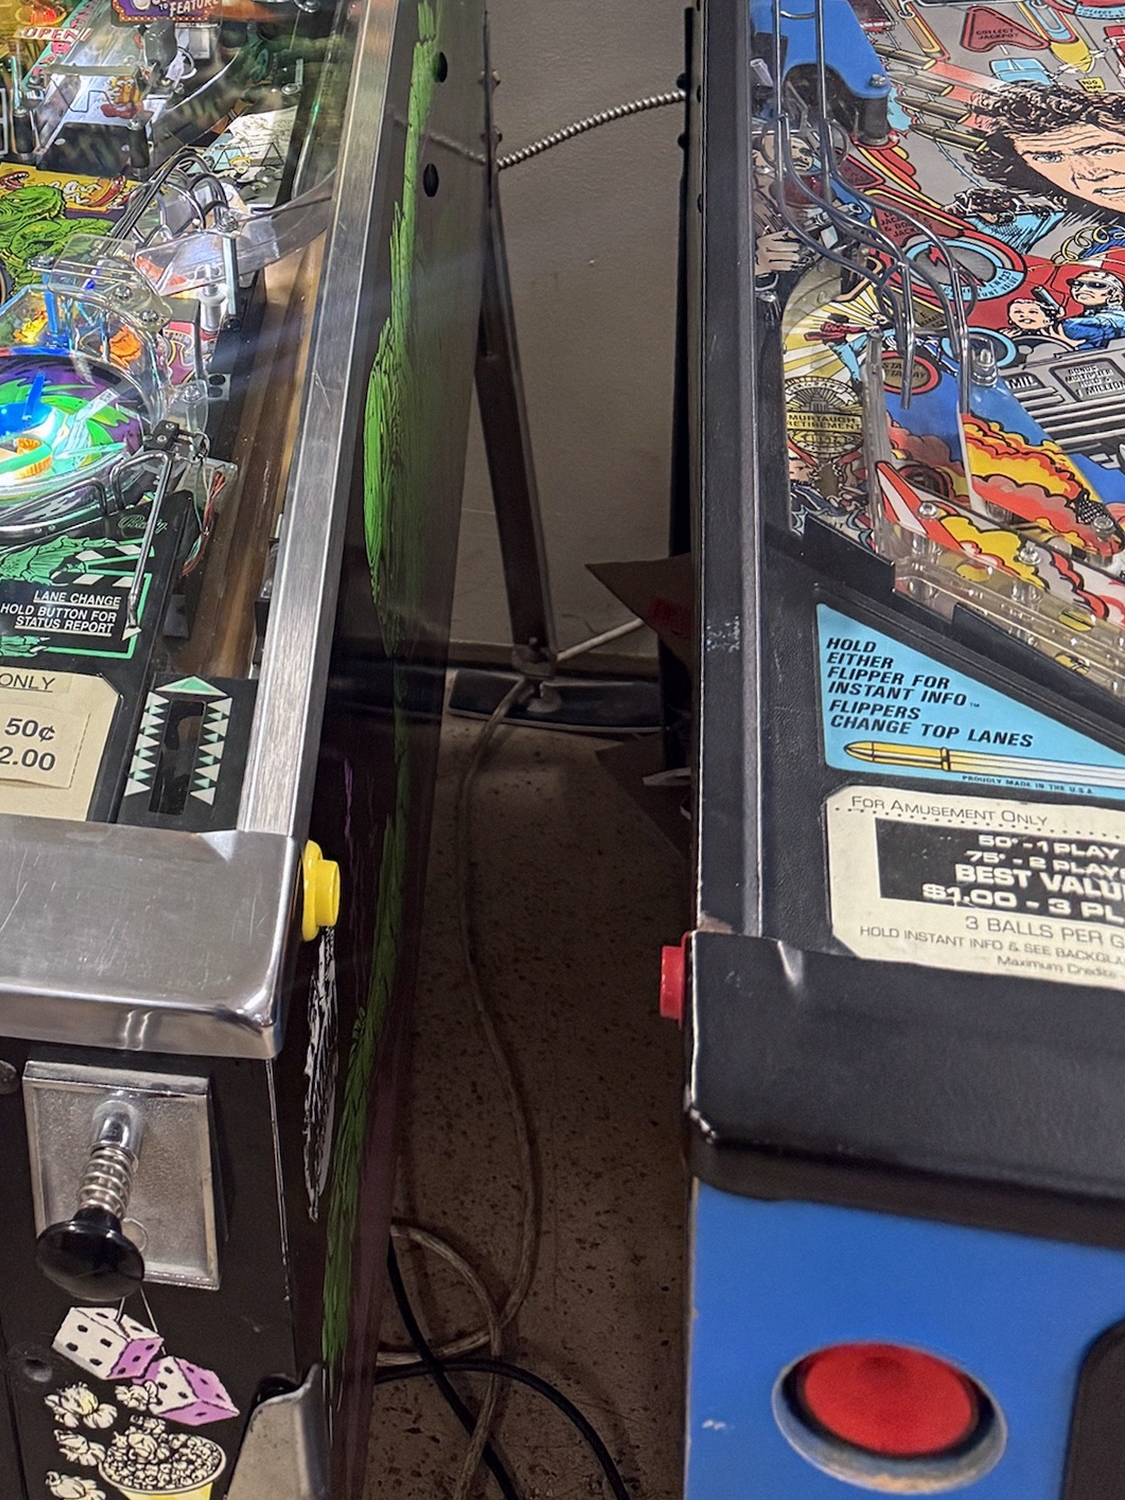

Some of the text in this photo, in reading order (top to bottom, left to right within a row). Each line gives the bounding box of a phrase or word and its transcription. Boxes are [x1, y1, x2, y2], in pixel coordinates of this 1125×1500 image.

[788, 415, 857, 425] MURTAUGH
[117, 514, 168, 534] Baly
[33, 590, 122, 607] LANE CHANGE
[0, 603, 118, 623] HOLD BUTTON FOR
[15, 615, 114, 634] STATUS REPORT
[826, 637, 877, 653] HOLD
[827, 652, 894, 669] EITHER
[827, 666, 950, 690] FLIPPER FOR
[828, 681, 915, 701] INSTANT
[921, 690, 967, 707] INFO
[829, 700, 921, 720] FLIPPERS
[4, 717, 57, 743] 50¢
[830, 716, 1034, 748] CHANGE TOP LANES
[962, 775, 1002, 784] PROUDLY
[1053, 842, 1119, 860] PLAY
[1029, 856, 1047, 870] 2
[955, 864, 1125, 901] BEST VALU
[923, 883, 1017, 908] $1.00
[1048, 898, 1071, 915] 3
[860, 926, 900, 939] HOLD
[904, 930, 965, 947] INSTANT
[970, 938, 1004, 950] INFO
[1009, 941, 1020, 951] &
[1024, 944, 1052, 955] SEE
[966, 916, 979, 930] 3
[988, 918, 1053, 939] BALLS
[1061, 928, 1103, 945] PER
[997, 955, 1063, 973] Maximum
